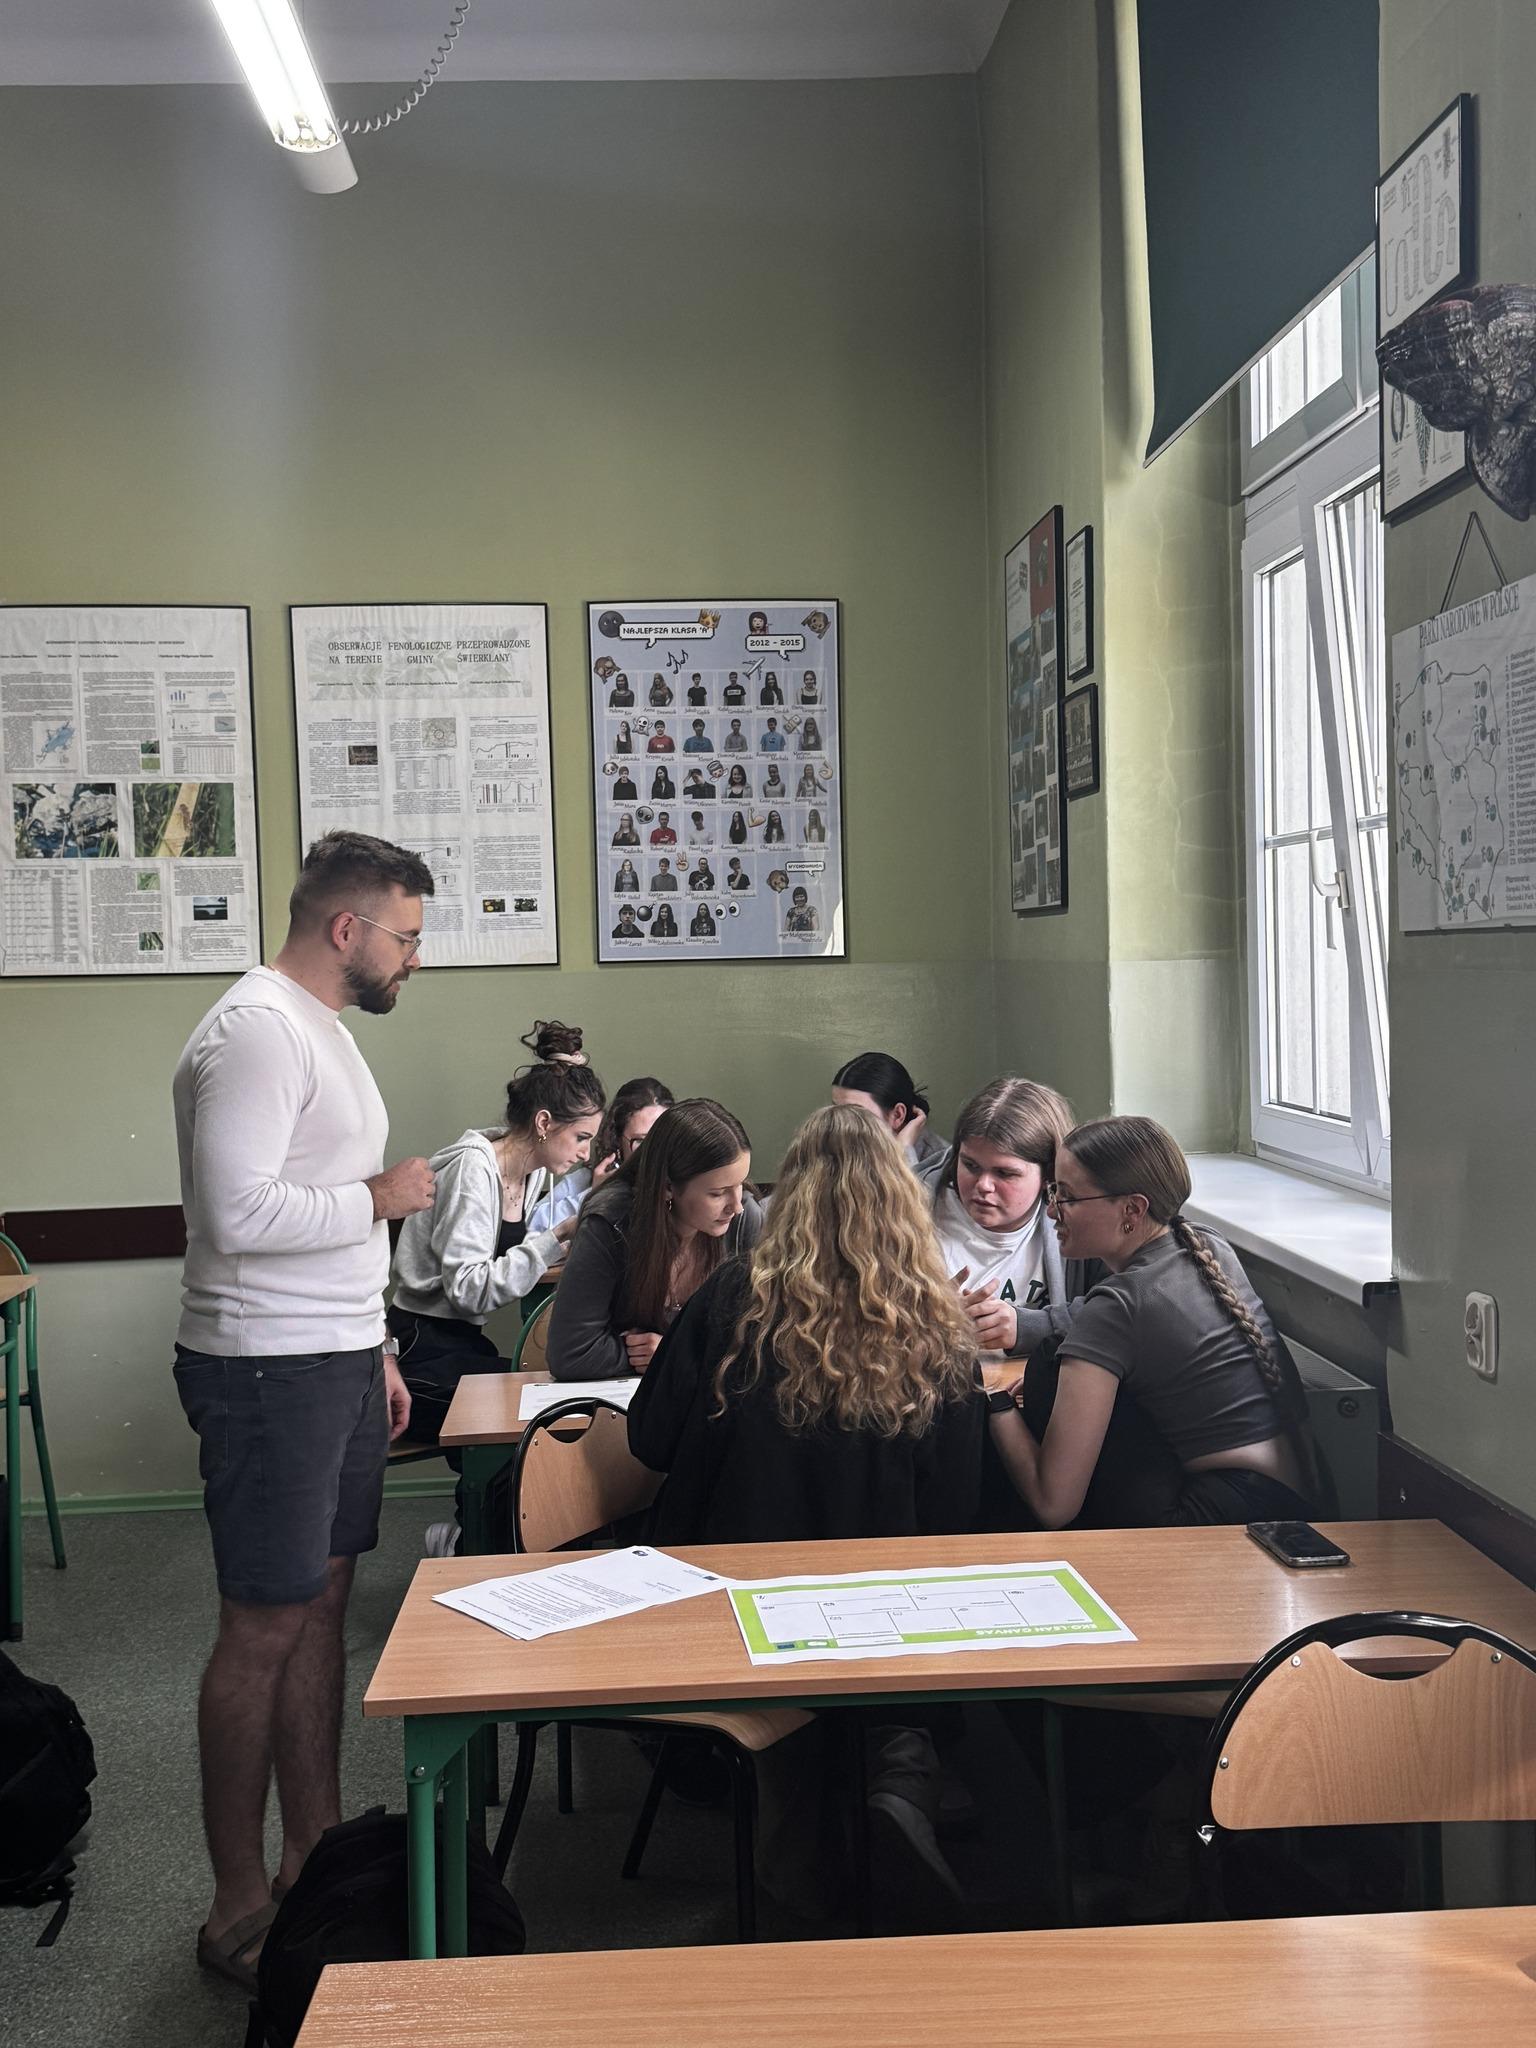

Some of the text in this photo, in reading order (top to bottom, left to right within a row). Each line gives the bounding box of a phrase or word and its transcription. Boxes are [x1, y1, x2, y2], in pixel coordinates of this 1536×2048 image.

[1419, 583, 1520, 648] PARKI NARODOWE W POLSCE
[671, 626, 697, 634] KLASA
[328, 639, 531, 651] OBSERWACJE FENOLOGICZNE PRZEPROWADZONE
[750, 639, 770, 647] 2012
[780, 638, 801, 646] 2015
[329, 653, 510, 664] NA TERENIE GMINY ŚWIERKLANY
